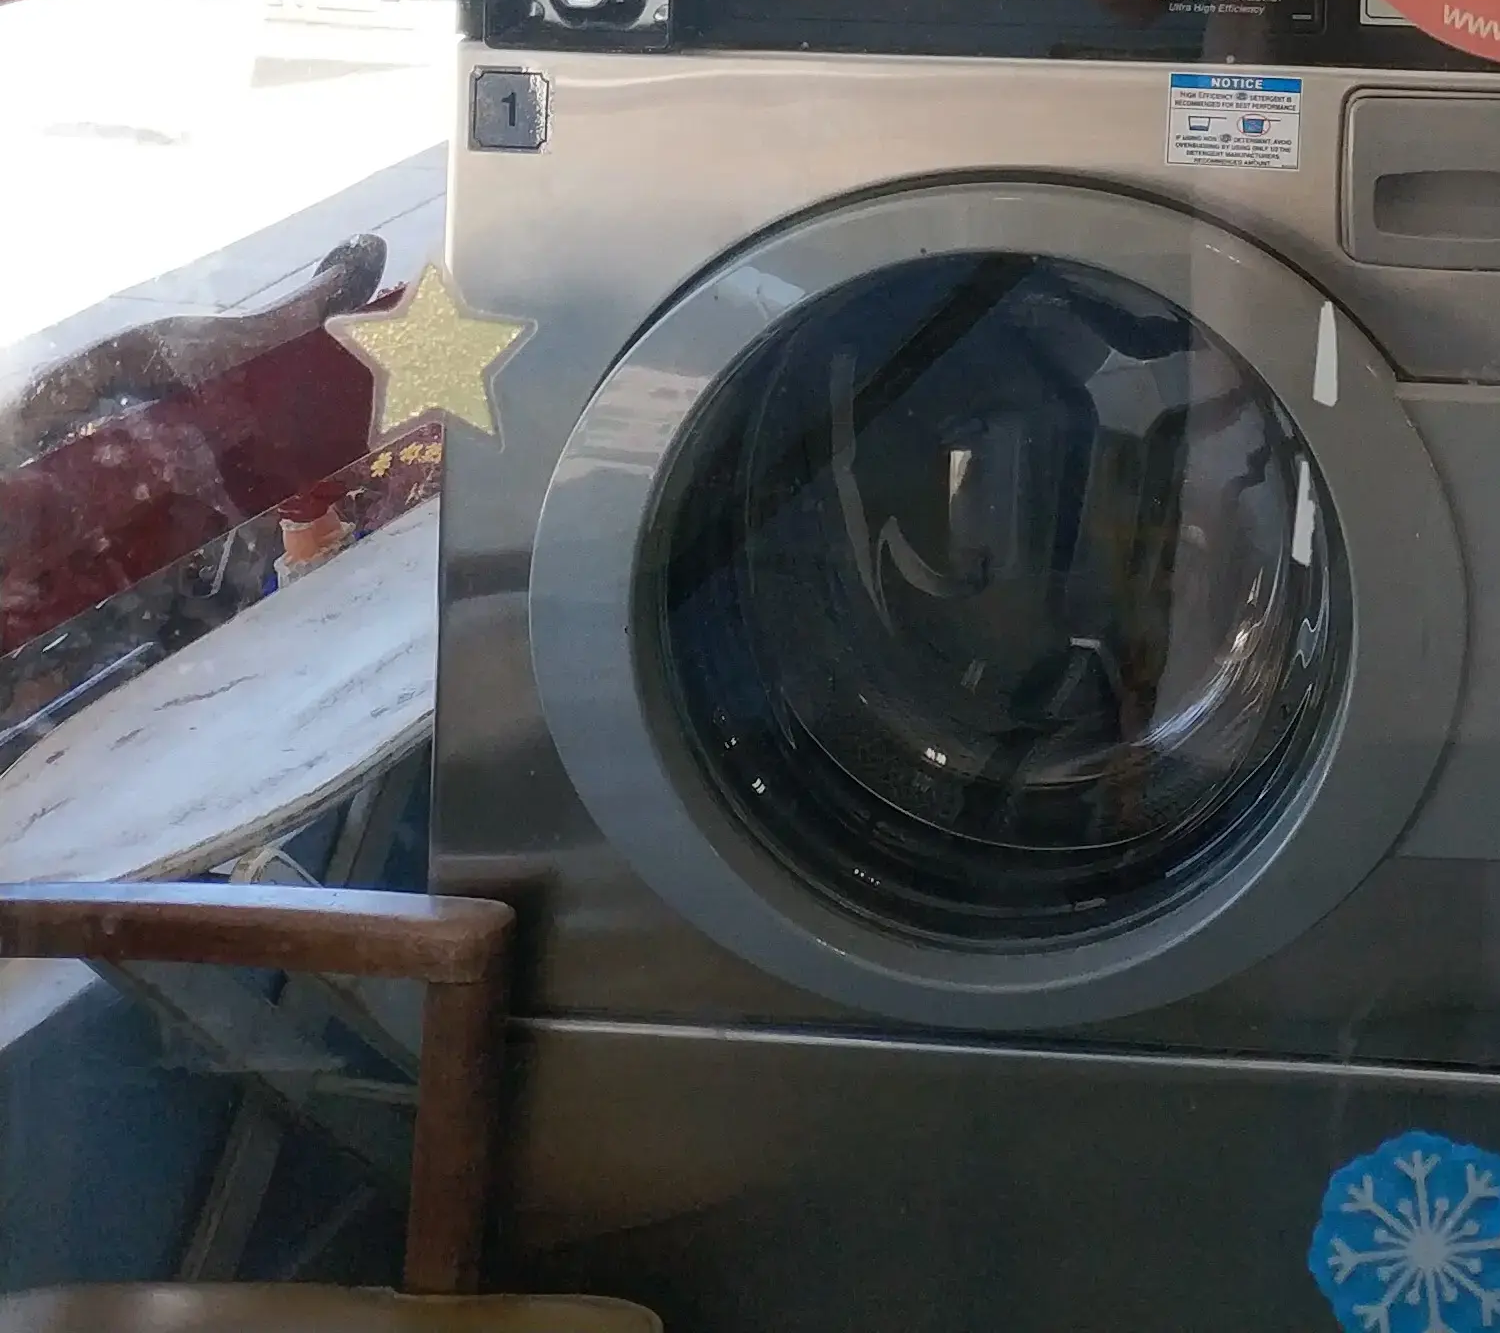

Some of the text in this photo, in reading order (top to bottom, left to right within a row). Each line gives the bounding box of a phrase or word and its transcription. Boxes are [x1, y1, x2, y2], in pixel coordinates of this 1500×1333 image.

[1168, 3, 1266, 16] Ultra High Efficiency
[1211, 78, 1264, 89] NOTICE
[501, 92, 516, 127] 1
